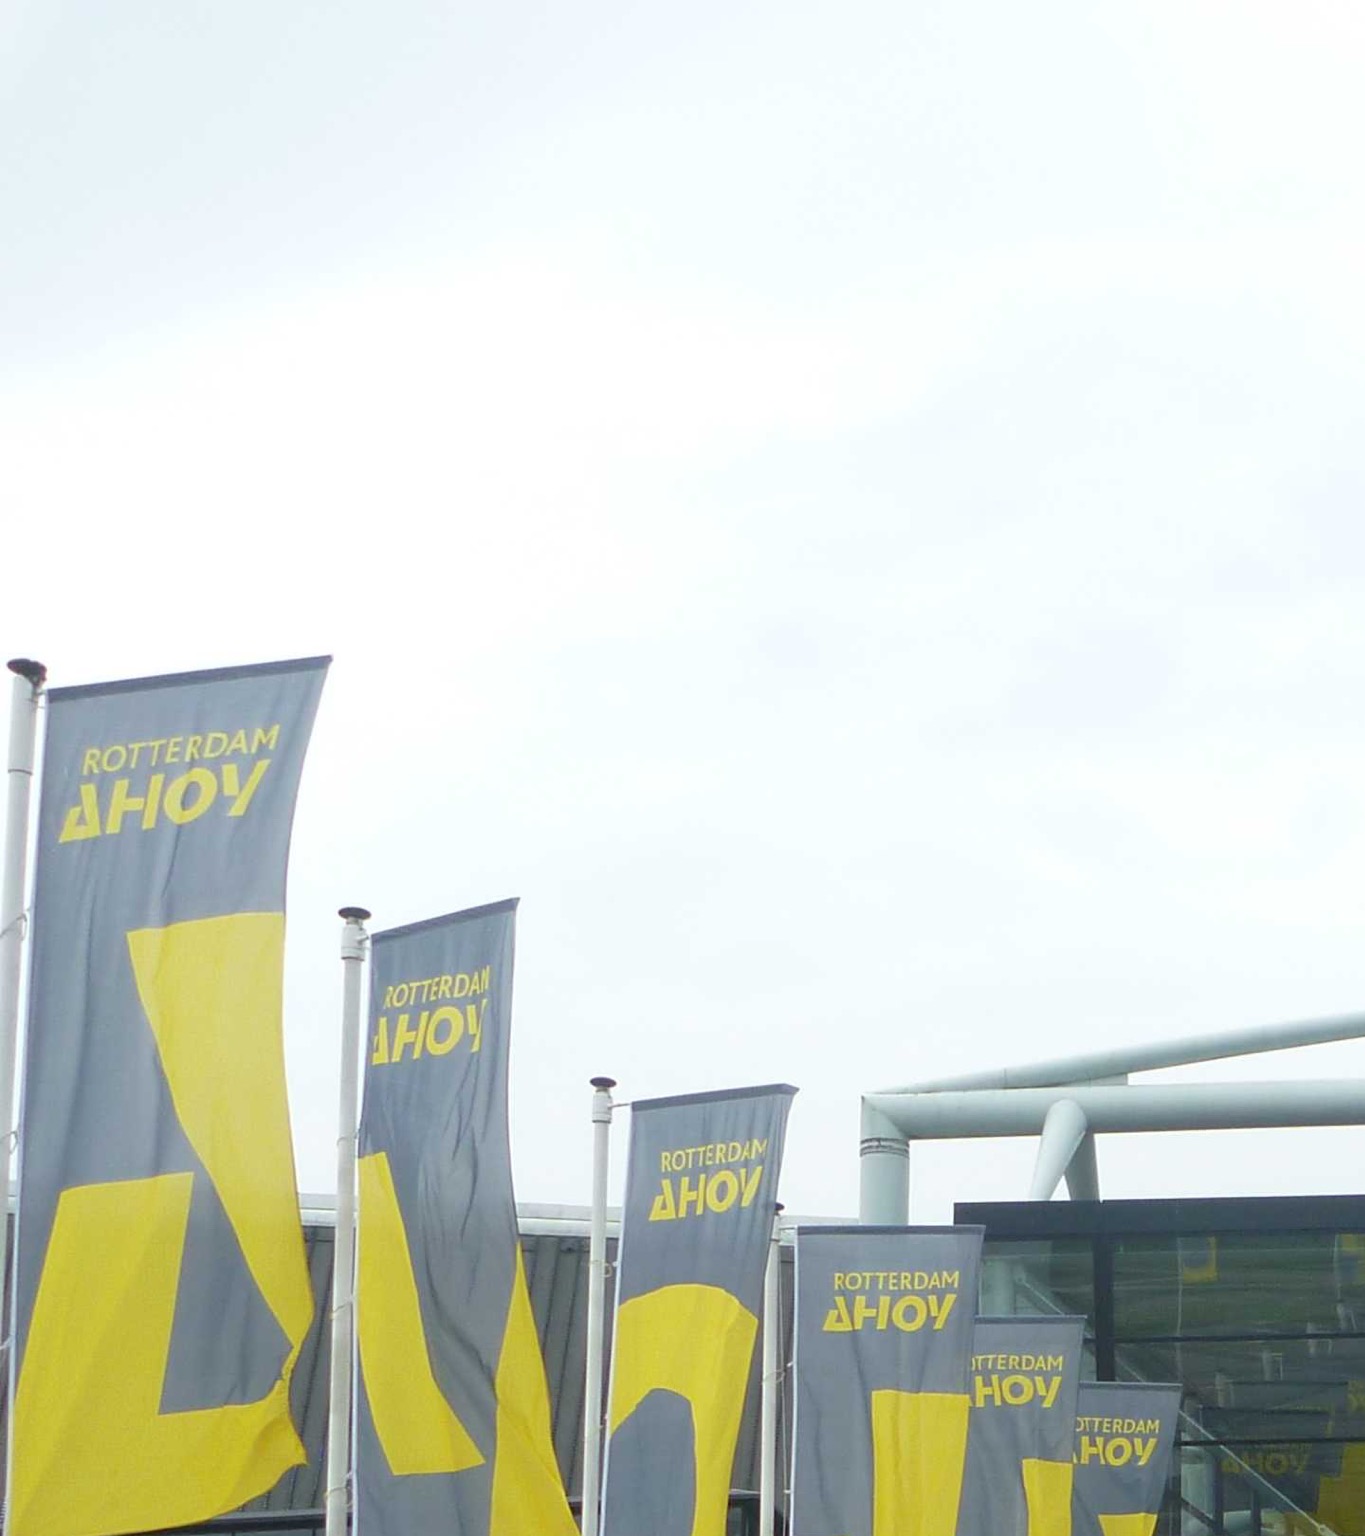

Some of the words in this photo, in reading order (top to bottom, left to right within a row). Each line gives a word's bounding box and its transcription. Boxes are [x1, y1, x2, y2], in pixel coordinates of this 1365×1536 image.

[82, 725, 280, 774] ROTTERDAM
[58, 758, 271, 843] AHOY
[372, 998, 488, 1065] AHOY
[661, 1139, 768, 1172] ROTTERDAM
[649, 1166, 763, 1221] AHOY
[834, 1271, 959, 1290] ROTTERDAM
[823, 1294, 956, 1331] AHOY
[971, 1354, 1063, 1371] TTERDAM
[970, 1374, 1062, 1408] HOY
[1075, 1417, 1160, 1434] OTTERDAM
[1073, 1436, 1157, 1467] HOY
